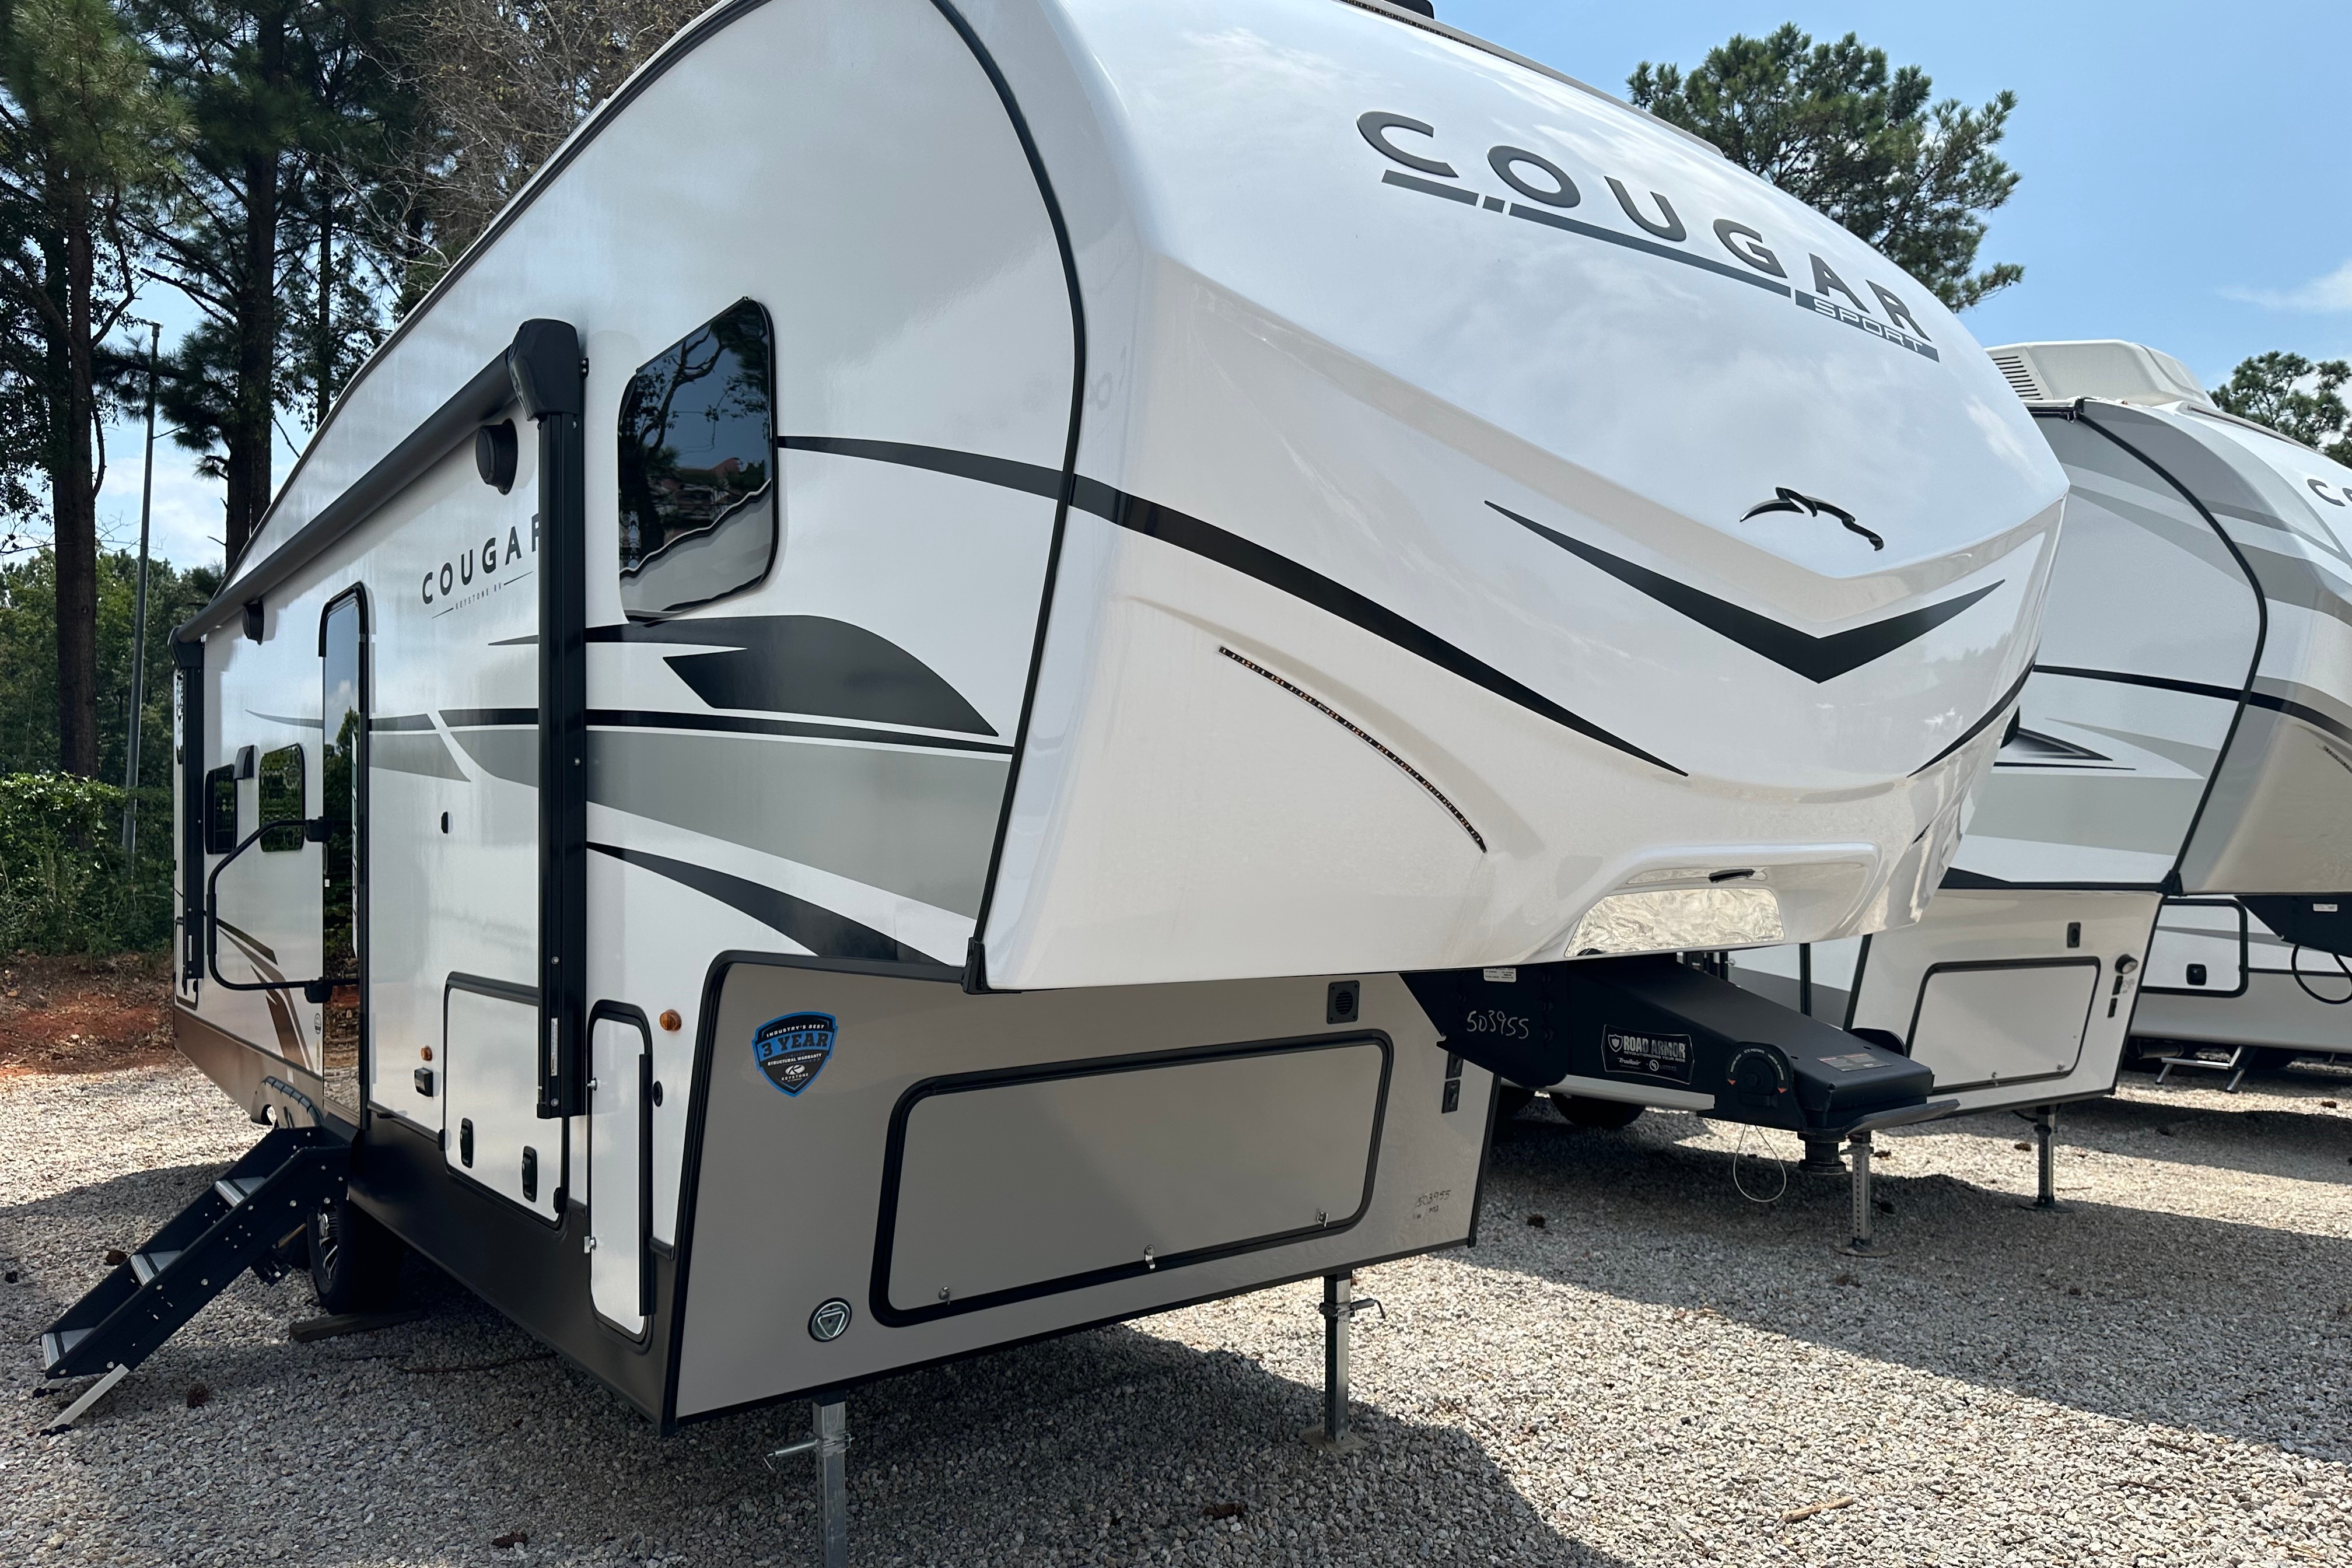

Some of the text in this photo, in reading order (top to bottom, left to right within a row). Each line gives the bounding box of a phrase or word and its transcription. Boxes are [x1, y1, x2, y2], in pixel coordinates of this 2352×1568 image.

[1357, 111, 1932, 342] COUGAR
[1814, 298, 1923, 352] SPORT
[456, 583, 502, 610] KEYSTONE RV
[766, 1024, 806, 1037] INDUSTRY'S
[1467, 1010, 1528, 1039] 503955
[761, 1032, 828, 1058] 3 YEAR
[1623, 1035, 1686, 1059] ROAD ARMOR
[768, 1053, 822, 1066] STRUCTURAL WARRANTY
[781, 1073, 808, 1081] KEYSTONE
[1417, 1190, 1451, 1207] 503955
